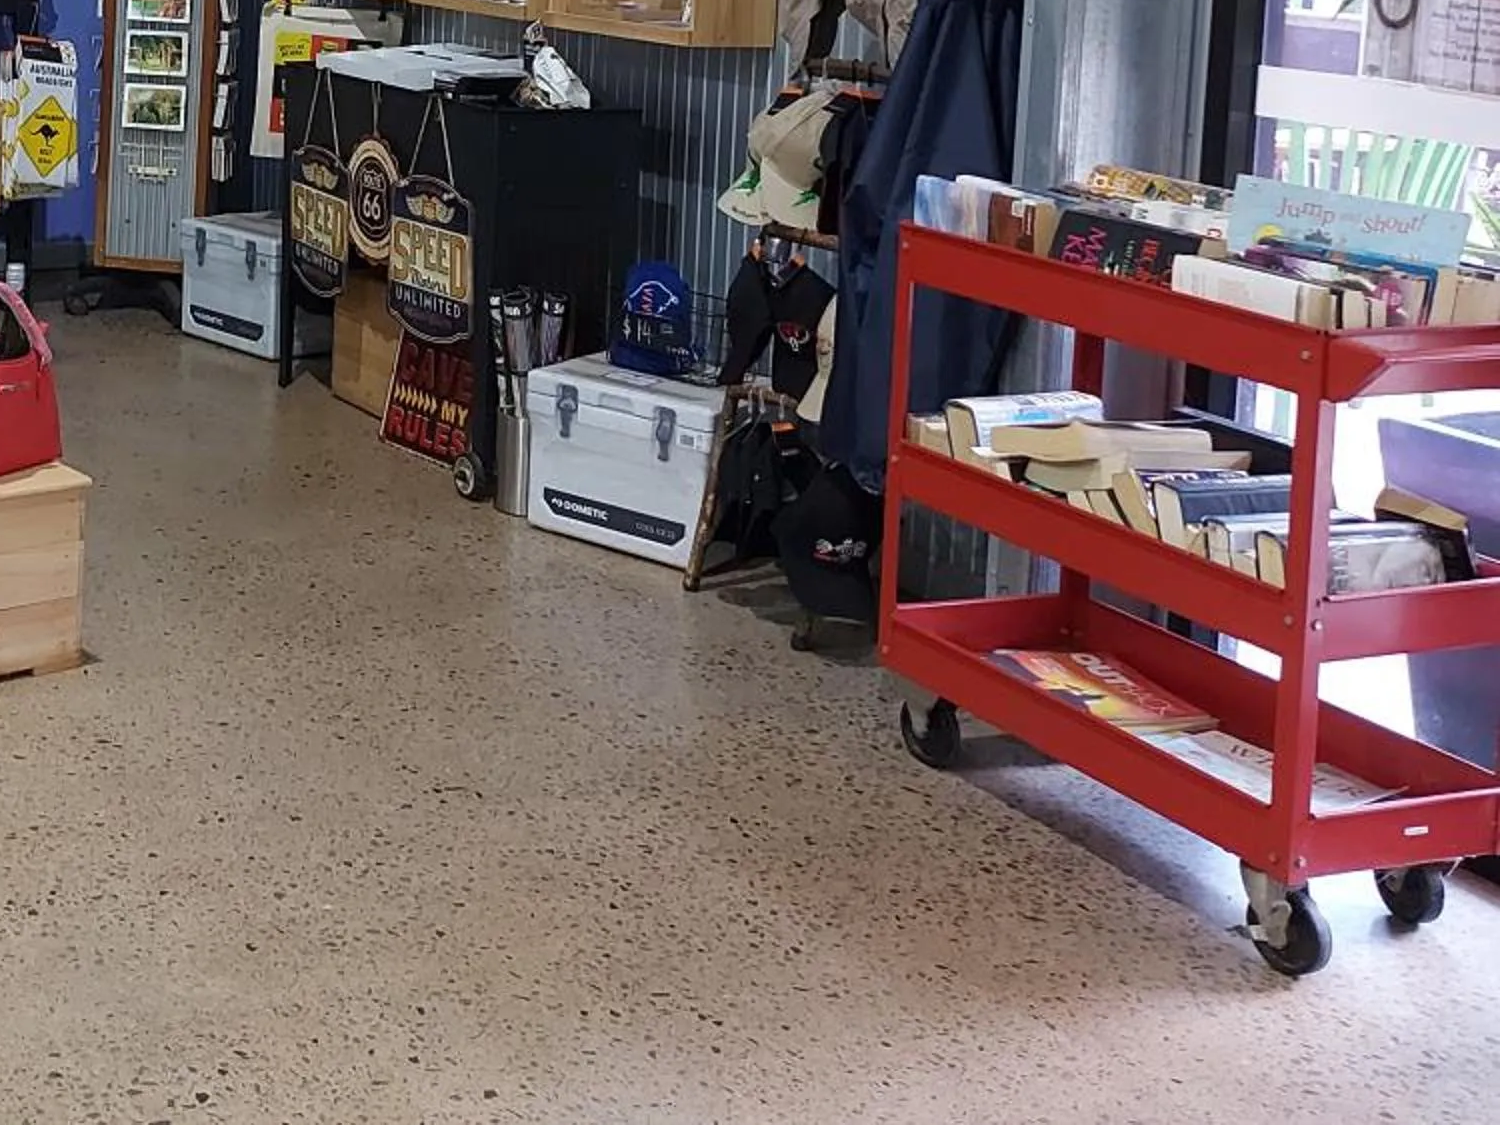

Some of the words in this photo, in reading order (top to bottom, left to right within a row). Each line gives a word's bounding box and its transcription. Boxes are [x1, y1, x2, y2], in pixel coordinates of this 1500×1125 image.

[292, 184, 346, 260] SPEED
[362, 193, 381, 221] 66
[393, 220, 467, 301] SPEED
[395, 283, 462, 319] UNLIMITED
[388, 404, 467, 456] RULES
[440, 400, 469, 428] MY
[563, 499, 609, 522] DOMETIC
